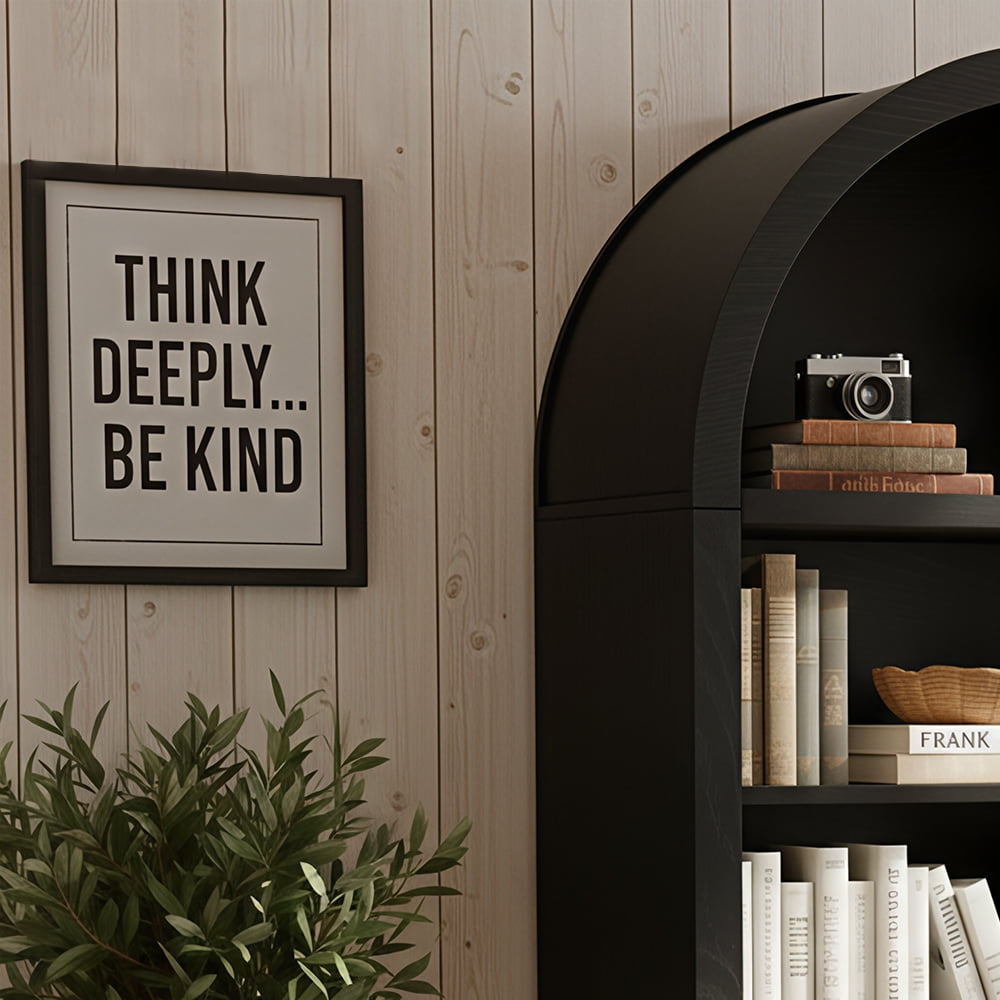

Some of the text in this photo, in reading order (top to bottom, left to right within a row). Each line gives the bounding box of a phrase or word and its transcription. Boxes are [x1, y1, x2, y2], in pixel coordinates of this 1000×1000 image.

[115, 254, 268, 326] THINK
[92, 338, 307, 411] DEEPLY...
[104, 423, 303, 493] BE KIND
[920, 731, 990, 749] FRANK
